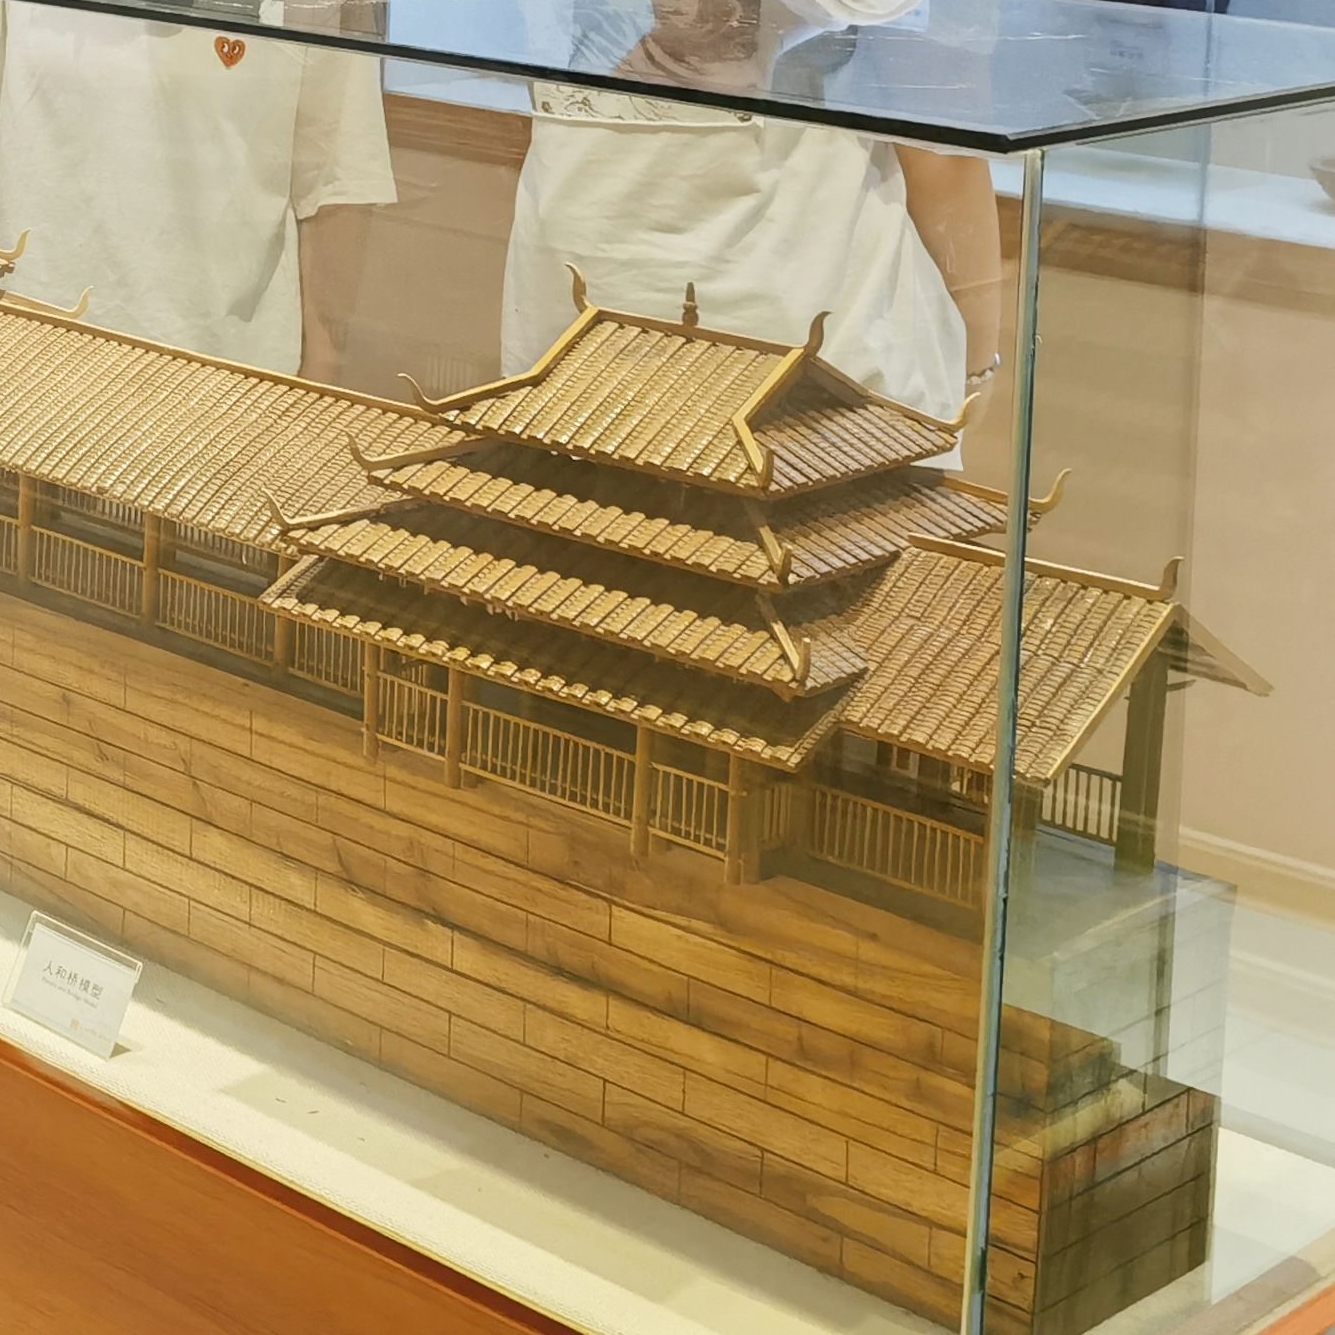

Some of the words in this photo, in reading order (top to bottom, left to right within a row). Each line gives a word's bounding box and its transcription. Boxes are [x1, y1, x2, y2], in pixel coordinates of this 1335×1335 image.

[42, 960, 103, 1000] 人和桥模型
